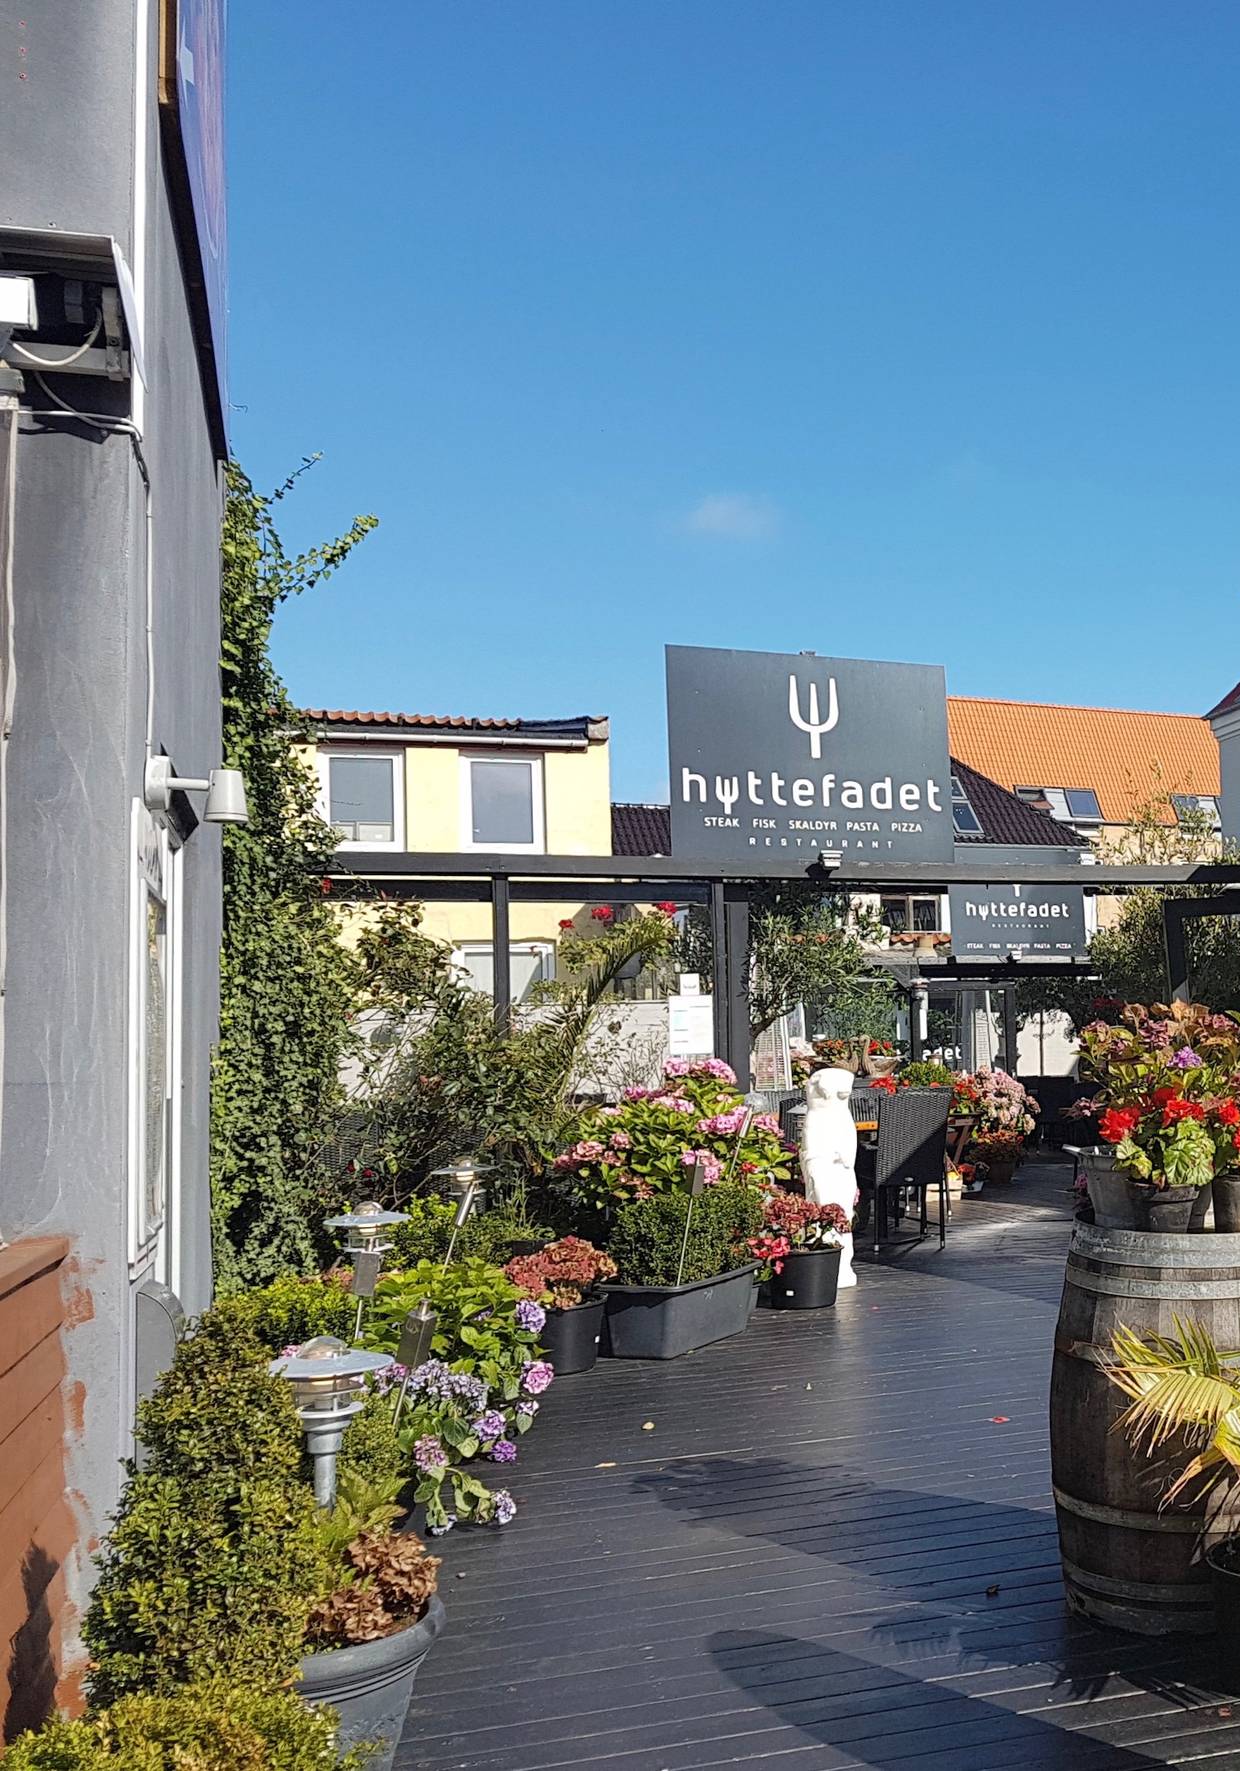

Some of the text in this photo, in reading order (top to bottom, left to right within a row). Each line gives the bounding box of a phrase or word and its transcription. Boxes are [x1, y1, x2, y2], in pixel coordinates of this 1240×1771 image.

[682, 767, 942, 814] hyttefadet
[704, 816, 922, 832] STEAK FISK SKALDYR PASTA PIZZA
[749, 837, 894, 848] RESTAURANT
[966, 902, 1069, 920] hyttefadet
